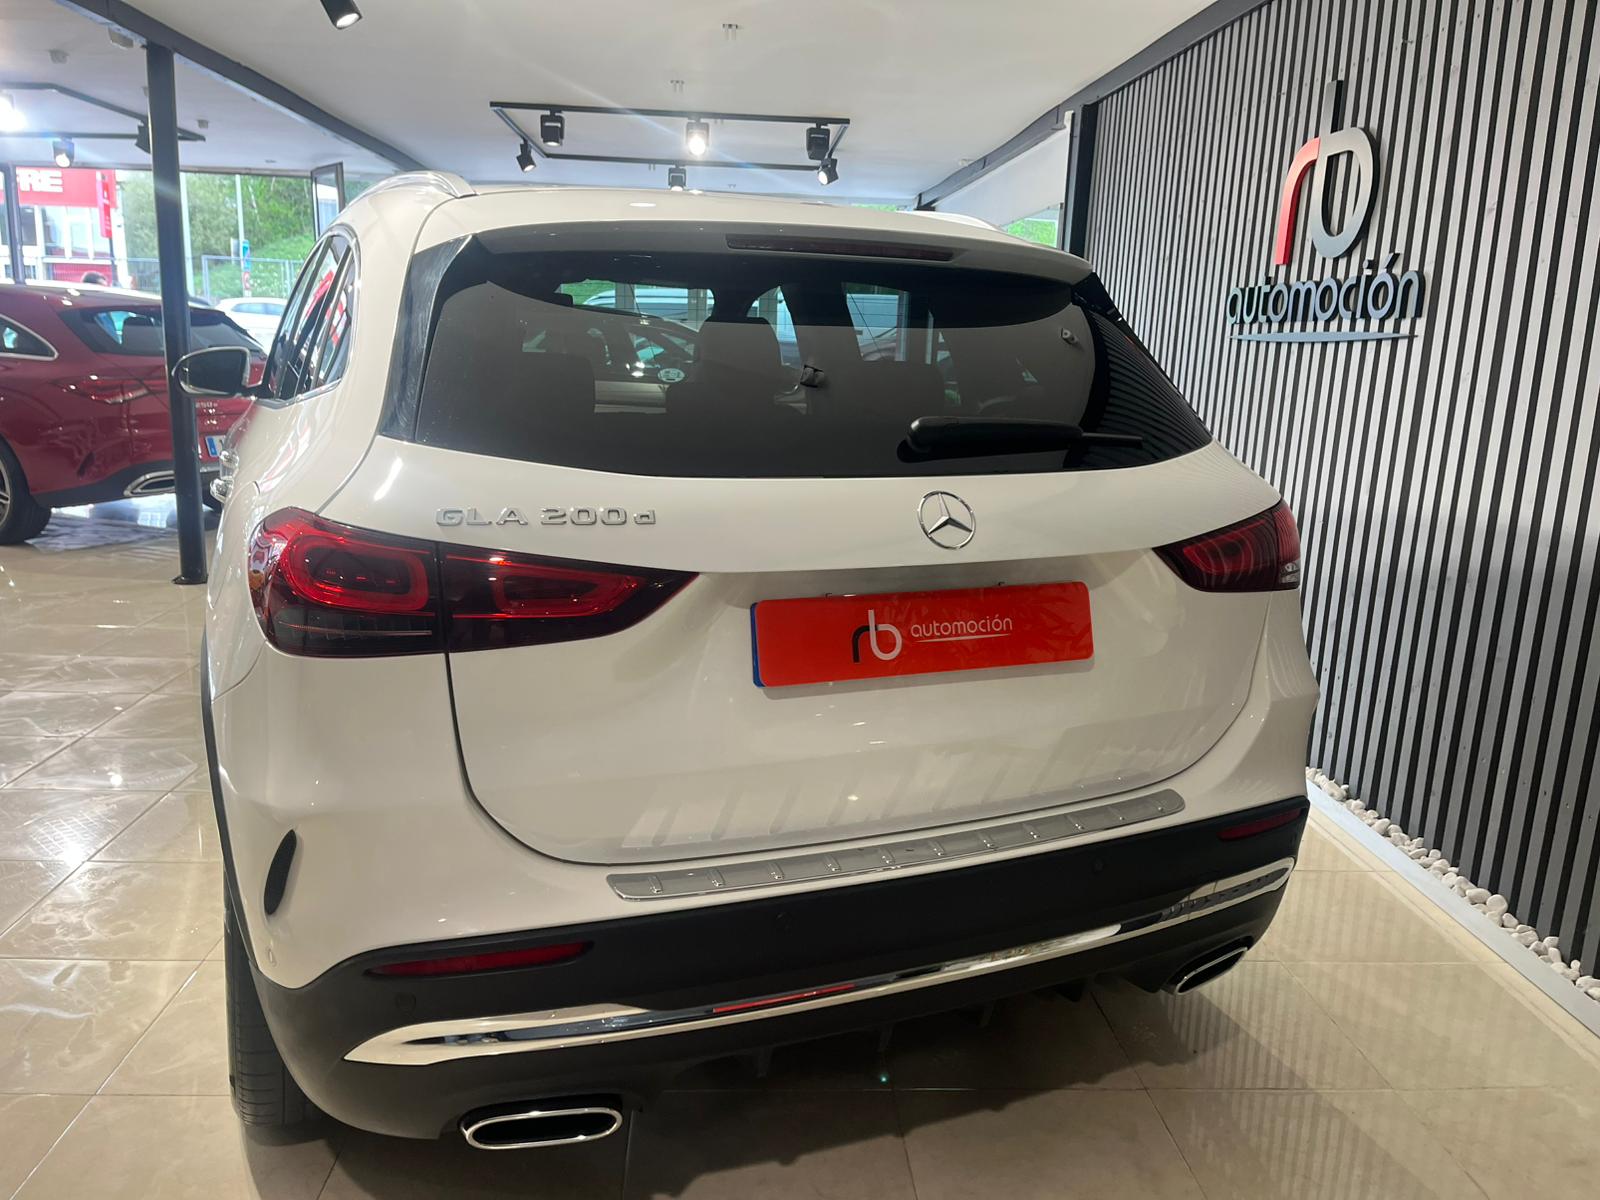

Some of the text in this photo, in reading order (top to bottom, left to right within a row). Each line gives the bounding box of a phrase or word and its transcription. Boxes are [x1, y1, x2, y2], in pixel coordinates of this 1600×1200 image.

[1226, 252, 1425, 324] automoción
[435, 506, 529, 527] GLA
[910, 615, 1013, 638] automoción
